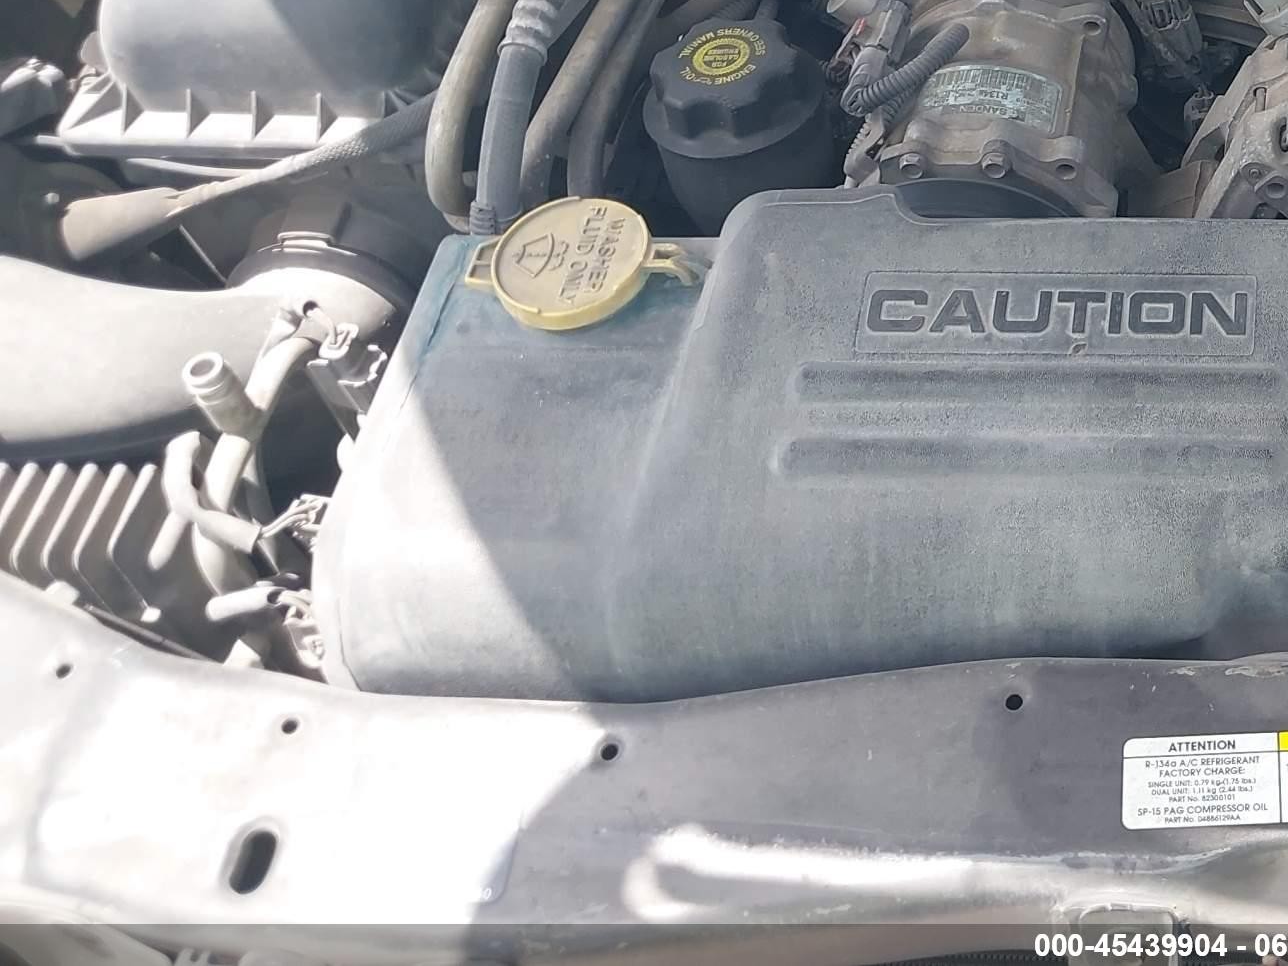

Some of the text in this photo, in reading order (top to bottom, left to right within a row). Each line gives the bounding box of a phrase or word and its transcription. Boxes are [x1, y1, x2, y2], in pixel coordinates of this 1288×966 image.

[678, 32, 715, 59] MANUAL
[680, 64, 757, 86] ENGINE OIL
[959, 105, 1008, 116] SANDEN
[557, 206, 608, 307] FLUID ONLY
[584, 217, 626, 293] WASHER
[866, 289, 1249, 336] CAUTION
[1168, 740, 1236, 753] ATTENTION
[1144, 755, 1260, 769] R-134a A/C REFRIGERANT
[1159, 766, 1246, 778] FACTORY CHARGE:
[1147, 780, 1173, 789] SINGLE
[1151, 788, 1170, 796] DUAL
[1168, 795, 1187, 803] PART
[1137, 802, 1269, 817] SP-15 PAG COMPRESSOR OIL
[1164, 816, 1182, 824] PART
